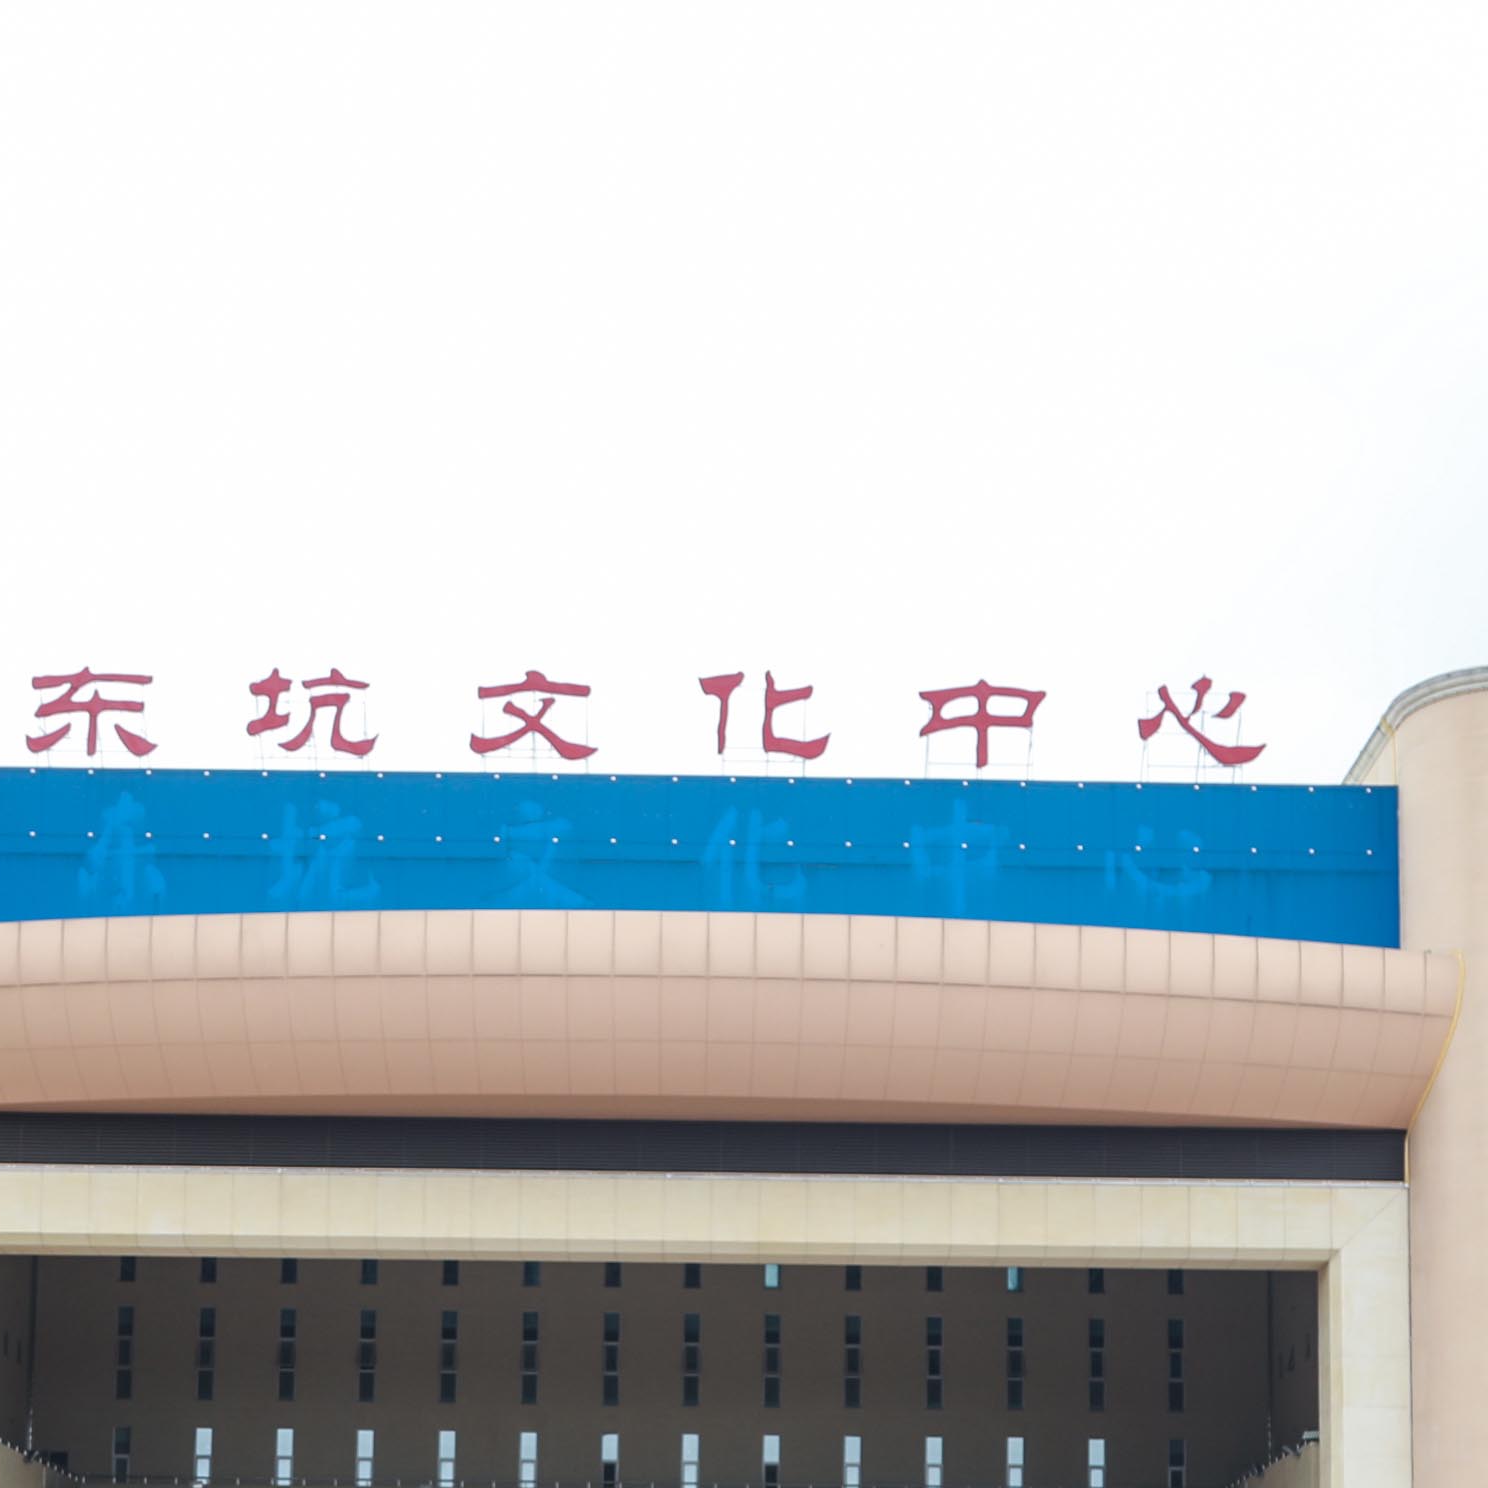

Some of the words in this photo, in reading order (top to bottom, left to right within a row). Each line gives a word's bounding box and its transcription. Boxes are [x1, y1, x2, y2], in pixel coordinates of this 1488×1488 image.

[25, 666, 1269, 772] 东坑文化中心
